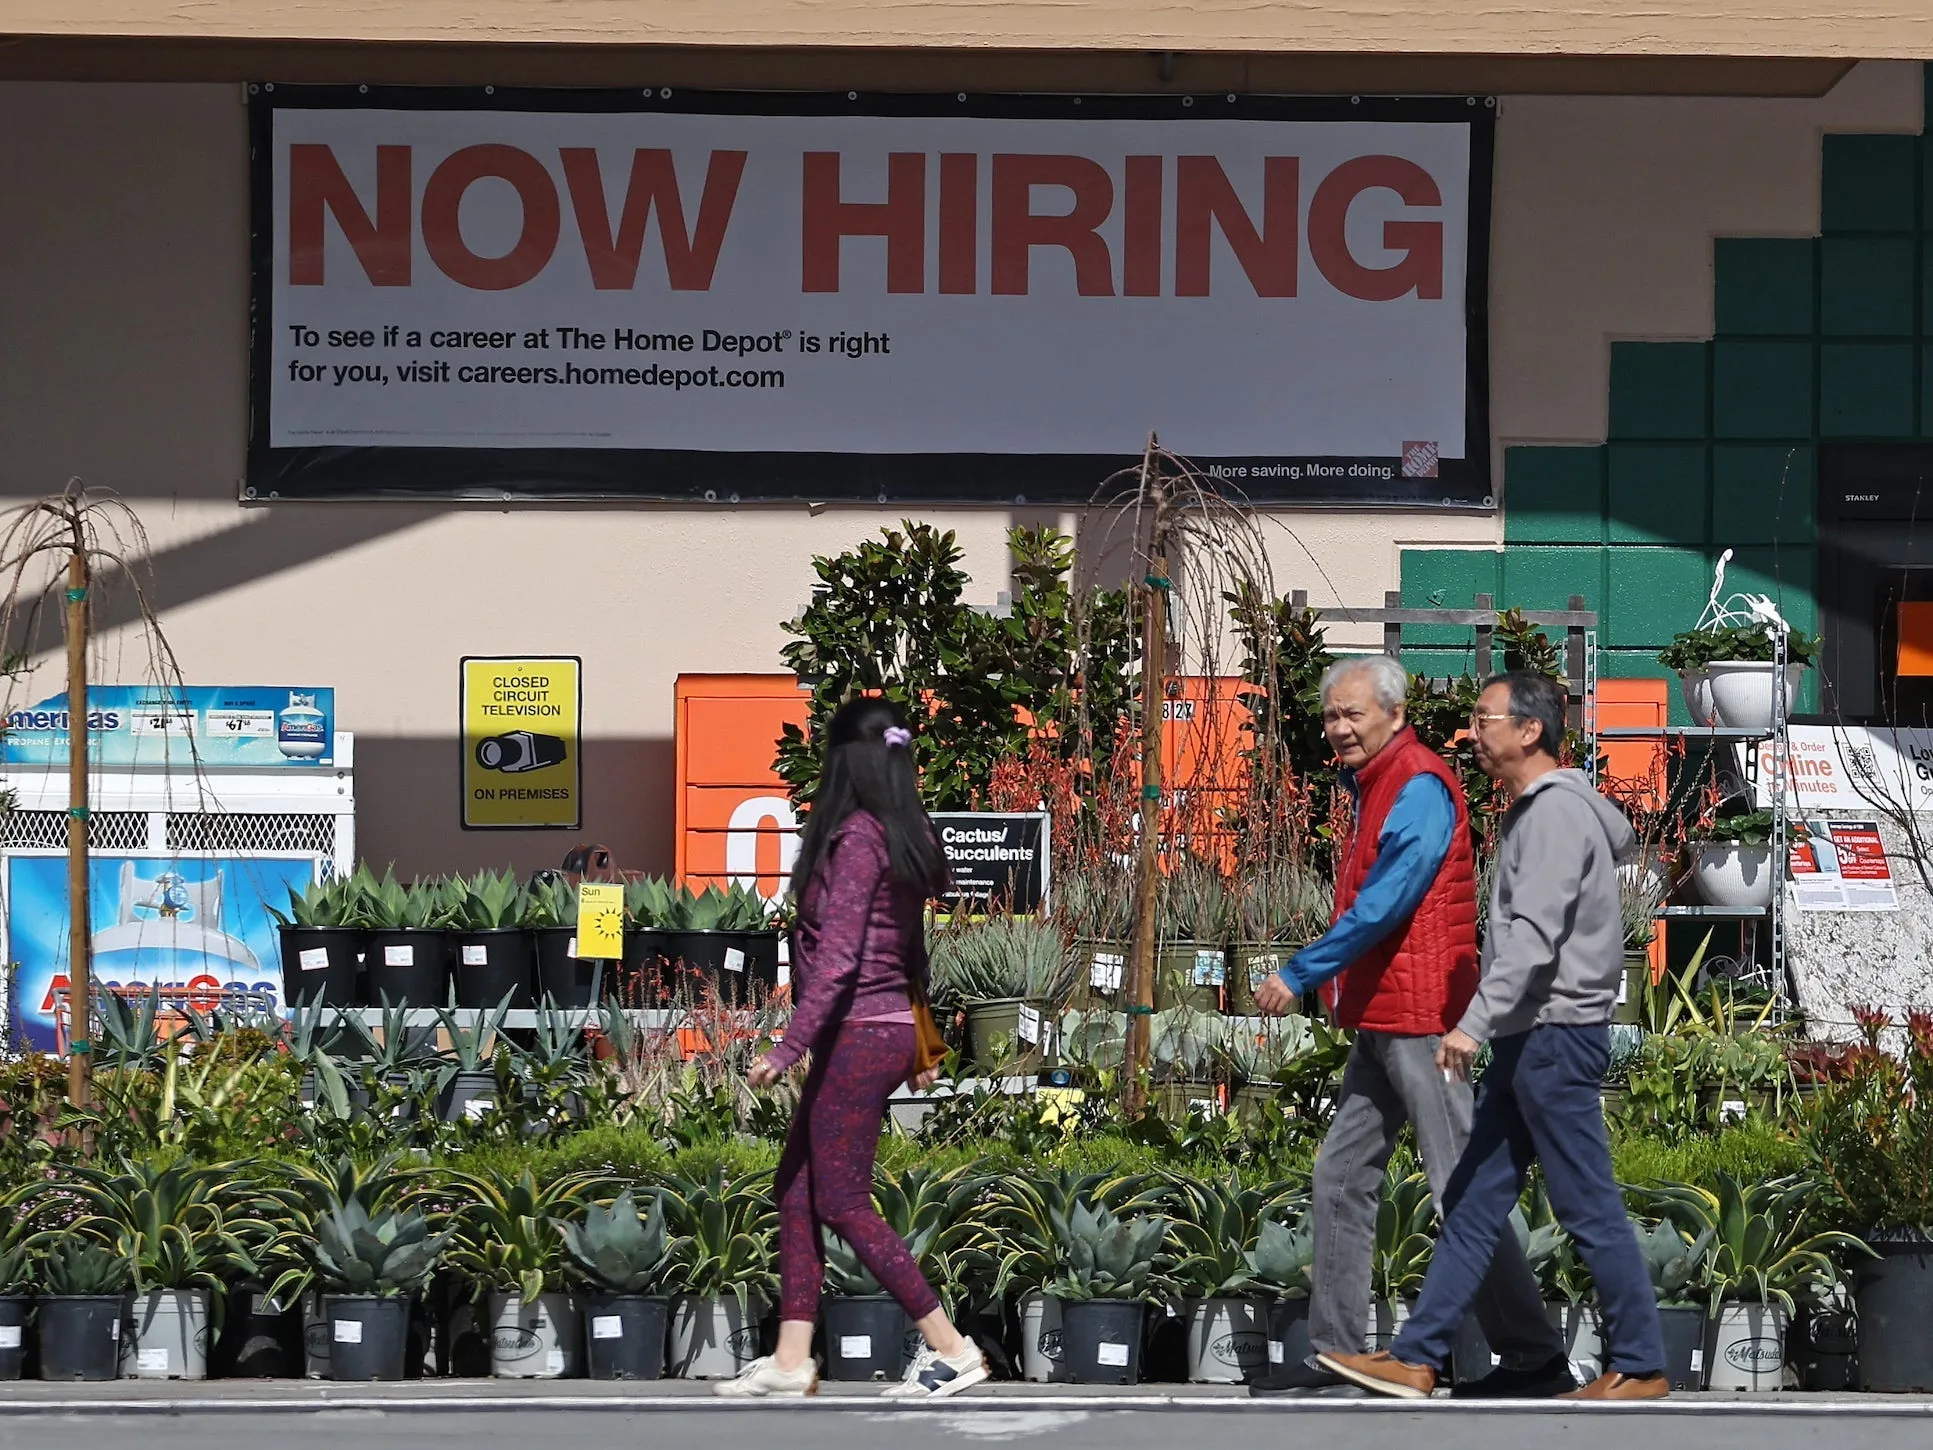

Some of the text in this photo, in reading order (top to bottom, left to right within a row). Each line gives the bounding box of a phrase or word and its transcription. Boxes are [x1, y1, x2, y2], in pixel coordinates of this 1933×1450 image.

[289, 143, 1443, 301] NOW HIRING
[289, 325, 320, 347] To
[327, 329, 375, 347] see
[383, 326, 399, 347] if
[406, 331, 422, 347] a
[430, 330, 516, 349] career
[523, 328, 550, 349] at
[556, 328, 606, 350] The
[614, 329, 694, 351] Home
[800, 331, 820, 352] is
[829, 332, 890, 358] right
[289, 360, 785, 391] for you, visit careers.homedepot.com
[1209, 463, 1395, 479] More saving. More doing.
[493, 677, 549, 688] CLOSED
[493, 691, 549, 702] CIRCUIT
[482, 705, 561, 716] TELEVISION
[7, 711, 119, 729] merias
[1801, 742, 1826, 752] Order
[1785, 779, 1837, 793] Minutes
[474, 789, 569, 800] ON PREMISES
[942, 827, 1008, 843] Cactus/
[943, 845, 1034, 861] Succulents
[581, 887, 600, 896] Sun
